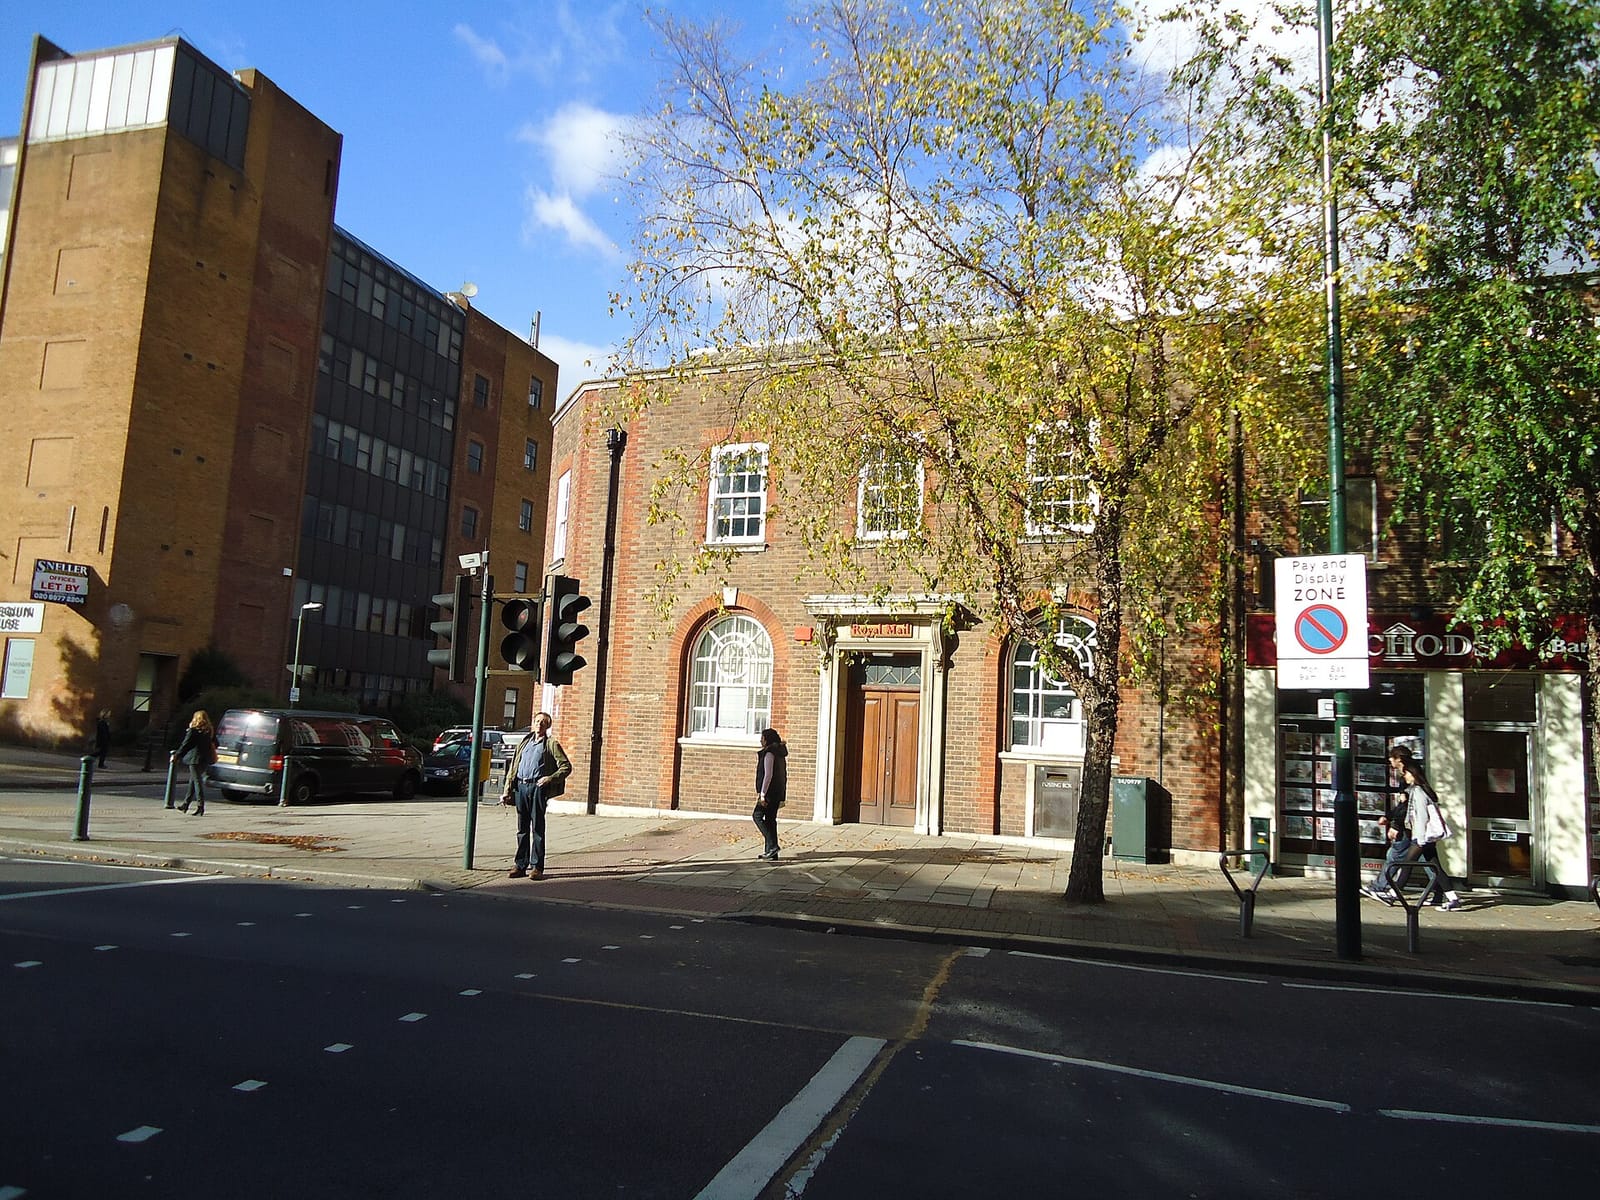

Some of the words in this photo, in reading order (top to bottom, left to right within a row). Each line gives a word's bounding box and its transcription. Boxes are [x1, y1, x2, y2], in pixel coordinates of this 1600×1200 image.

[36, 561, 88, 576] SNELLER
[1292, 560, 1316, 572] Pay
[1322, 559, 1347, 569] and
[49, 575, 76, 583] OFFICES
[1295, 574, 1345, 585] Display
[40, 581, 62, 590] LET
[65, 584, 80, 592] BY
[33, 592, 48, 600] 020
[1294, 587, 1346, 602] ZONE
[852, 623, 882, 636] Royal
[887, 623, 911, 635] Mail
